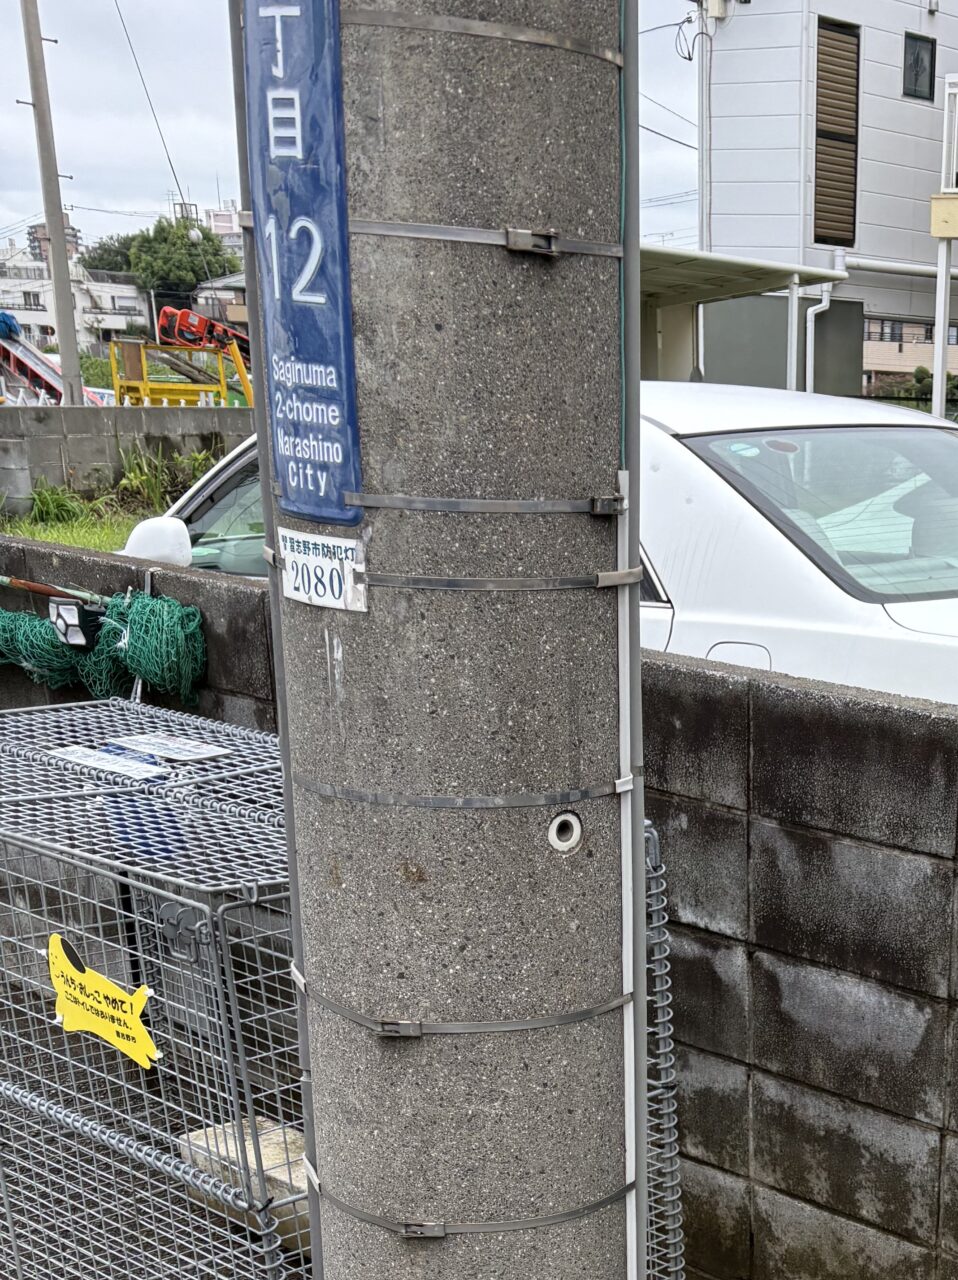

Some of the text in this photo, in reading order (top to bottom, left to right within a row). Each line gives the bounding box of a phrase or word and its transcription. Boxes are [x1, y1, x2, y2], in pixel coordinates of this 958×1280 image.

[258, 5, 303, 160] 丁目
[265, 214, 326, 304] 12
[272, 354, 337, 389] Saginuma
[275, 396, 340, 426] 2-chome
[277, 428, 343, 464] Narashino
[288, 461, 327, 497] City
[291, 560, 344, 601] 2080
